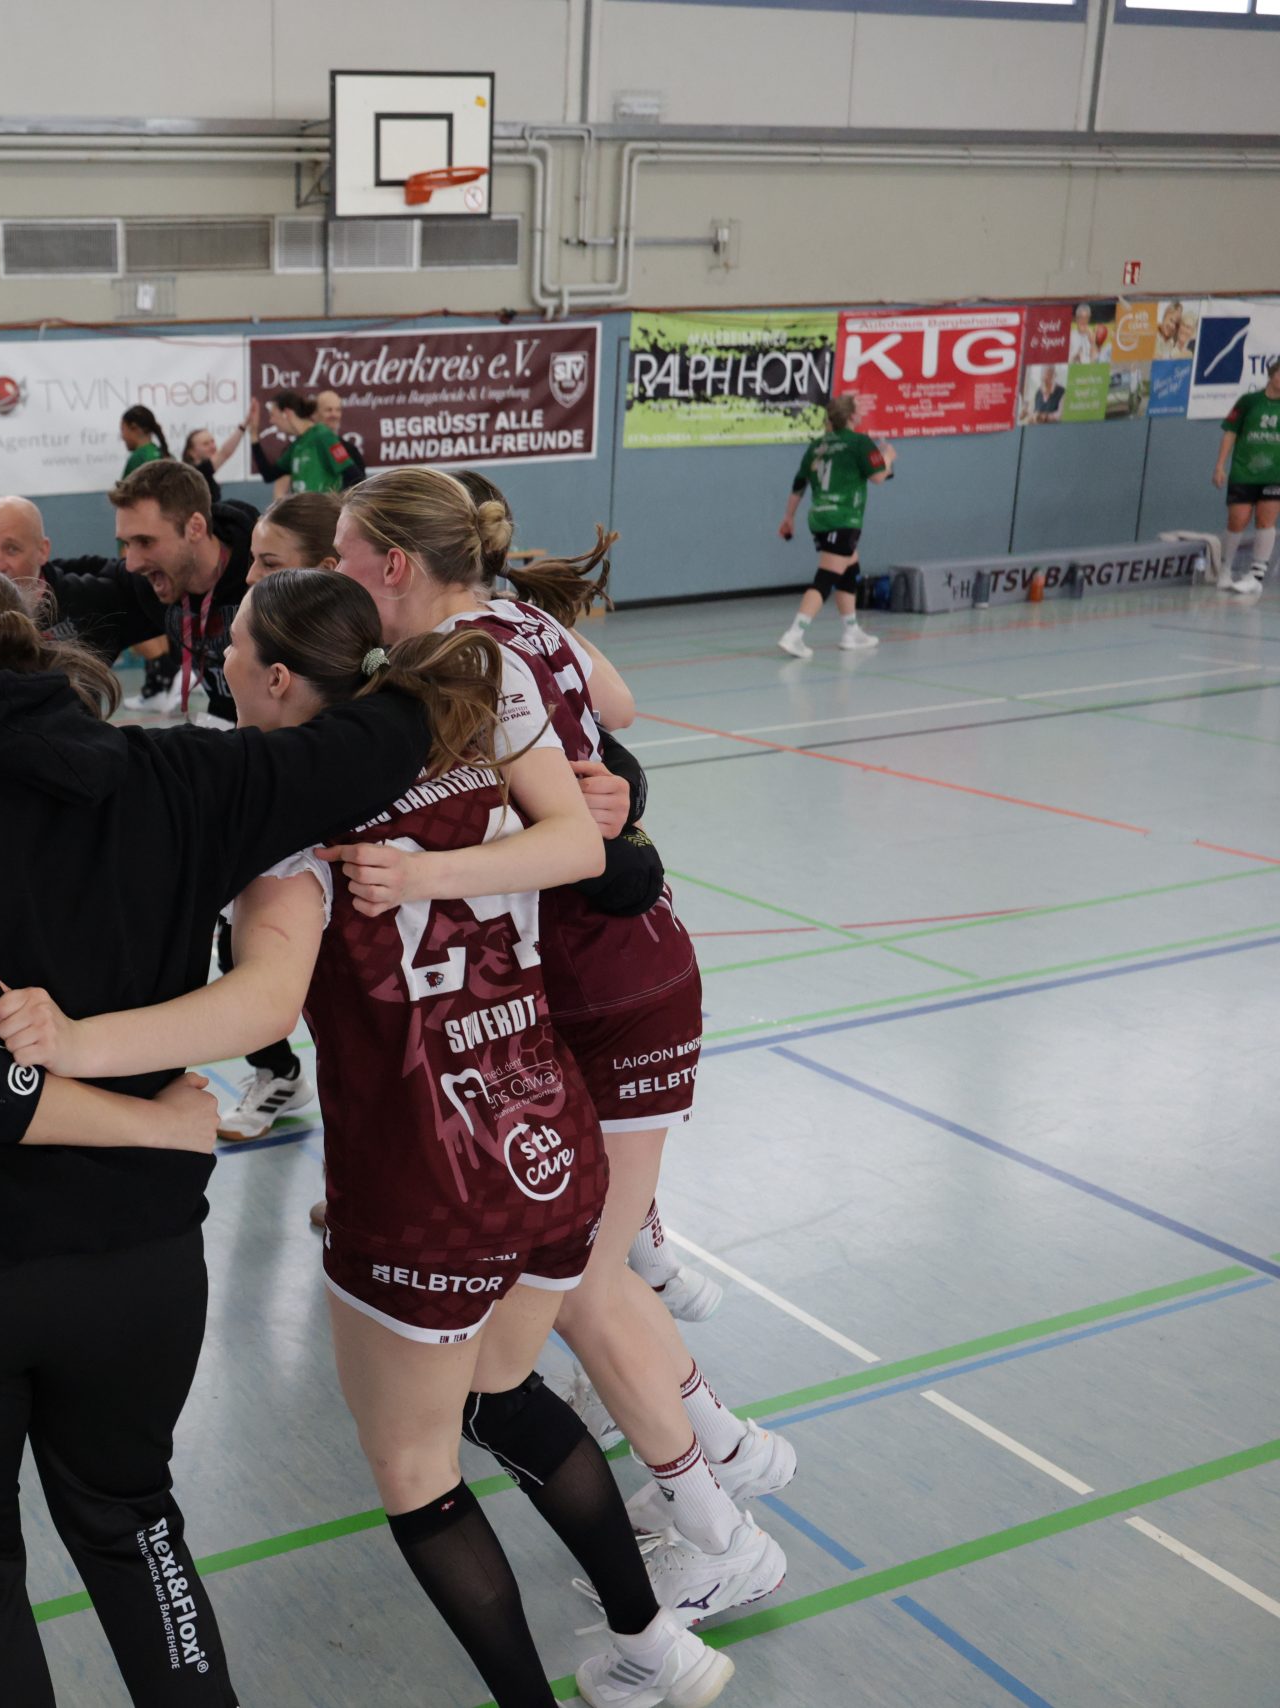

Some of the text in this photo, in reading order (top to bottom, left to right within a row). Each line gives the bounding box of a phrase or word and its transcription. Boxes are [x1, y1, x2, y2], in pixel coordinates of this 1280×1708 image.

[261, 338, 541, 389] Der Förderkreis e.V.
[842, 326, 1017, 382] KTG
[633, 351, 831, 398] RALPH HORN
[36, 374, 239, 413] TWIN media
[80, 426, 109, 446] für
[380, 409, 544, 438] BEGRÜSST ALLE
[380, 430, 585, 461] HANDBALLFREUNDE
[990, 569, 1039, 593] TSV
[613, 1047, 674, 1070] LAIQON
[520, 1125, 562, 1161] stb
[525, 1148, 575, 1186] care
[393, 1267, 503, 1293] ELBTOR
[154, 1583, 168, 1602] AUS
[159, 1602, 181, 1670] BARGTEHEIDE
